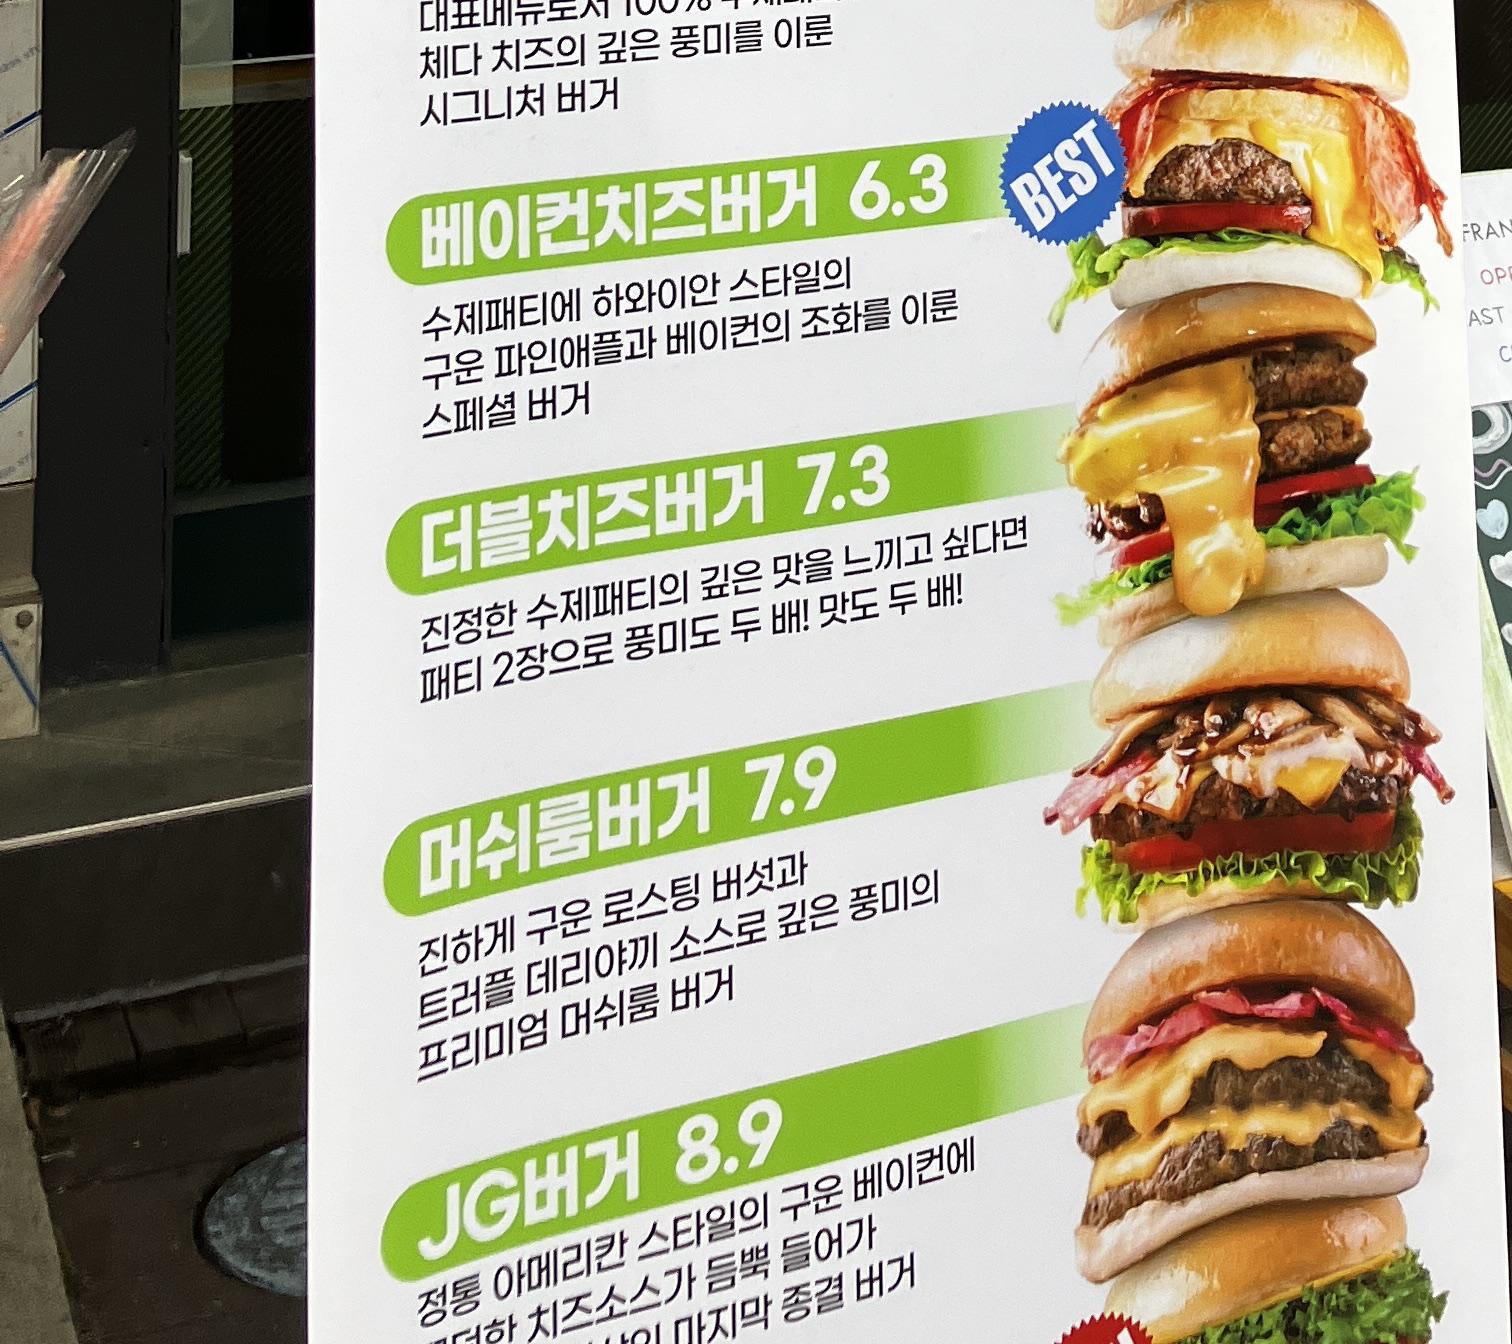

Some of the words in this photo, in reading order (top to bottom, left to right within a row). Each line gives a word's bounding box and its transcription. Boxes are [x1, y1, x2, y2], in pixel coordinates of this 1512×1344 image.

[419, 43, 481, 81] 체다
[491, 33, 585, 73] 치즈의
[598, 28, 661, 66] 깊은
[670, 20, 763, 58] 풍미를
[775, 14, 833, 50] 이룬
[419, 83, 546, 128] 시그니처
[557, 76, 619, 114] 버거
[421, 163, 816, 270] 베이컨치즈버거
[849, 153, 949, 216] 6.3
[1009, 118, 1115, 232] BEST
[422, 290, 581, 343] 수제패티에
[592, 274, 720, 320] 하와이안
[729, 256, 852, 303] 스타일의
[422, 348, 484, 391] 구운
[495, 331, 656, 380] 파인애플과
[666, 308, 791, 357] 베이컨의
[800, 296, 891, 340] 조화를
[901, 287, 958, 326] 이룬
[1468, 306, 1504, 327] AST
[422, 390, 516, 438] 스페셜
[528, 381, 591, 421] 버거
[420, 459, 765, 578] 더블치즈버거
[796, 444, 890, 516] 7.3
[420, 605, 517, 654] 진정한
[527, 574, 689, 634] 수제패티의
[700, 561, 762, 602] 깊은
[772, 548, 833, 591] 맛을
[843, 532, 933, 577] 느끼고
[941, 515, 1029, 561] 싶다면
[419, 768, 710, 897] 머쉬룸버거
[744, 745, 837, 823] 7.9
[419, 918, 516, 978] 진하게
[526, 898, 592, 940] 구운
[603, 871, 700, 925] 로스팅
[712, 851, 807, 902] 버섯과
[418, 1131, 639, 1261] JG버거
[675, 1098, 783, 1184] 8.9
